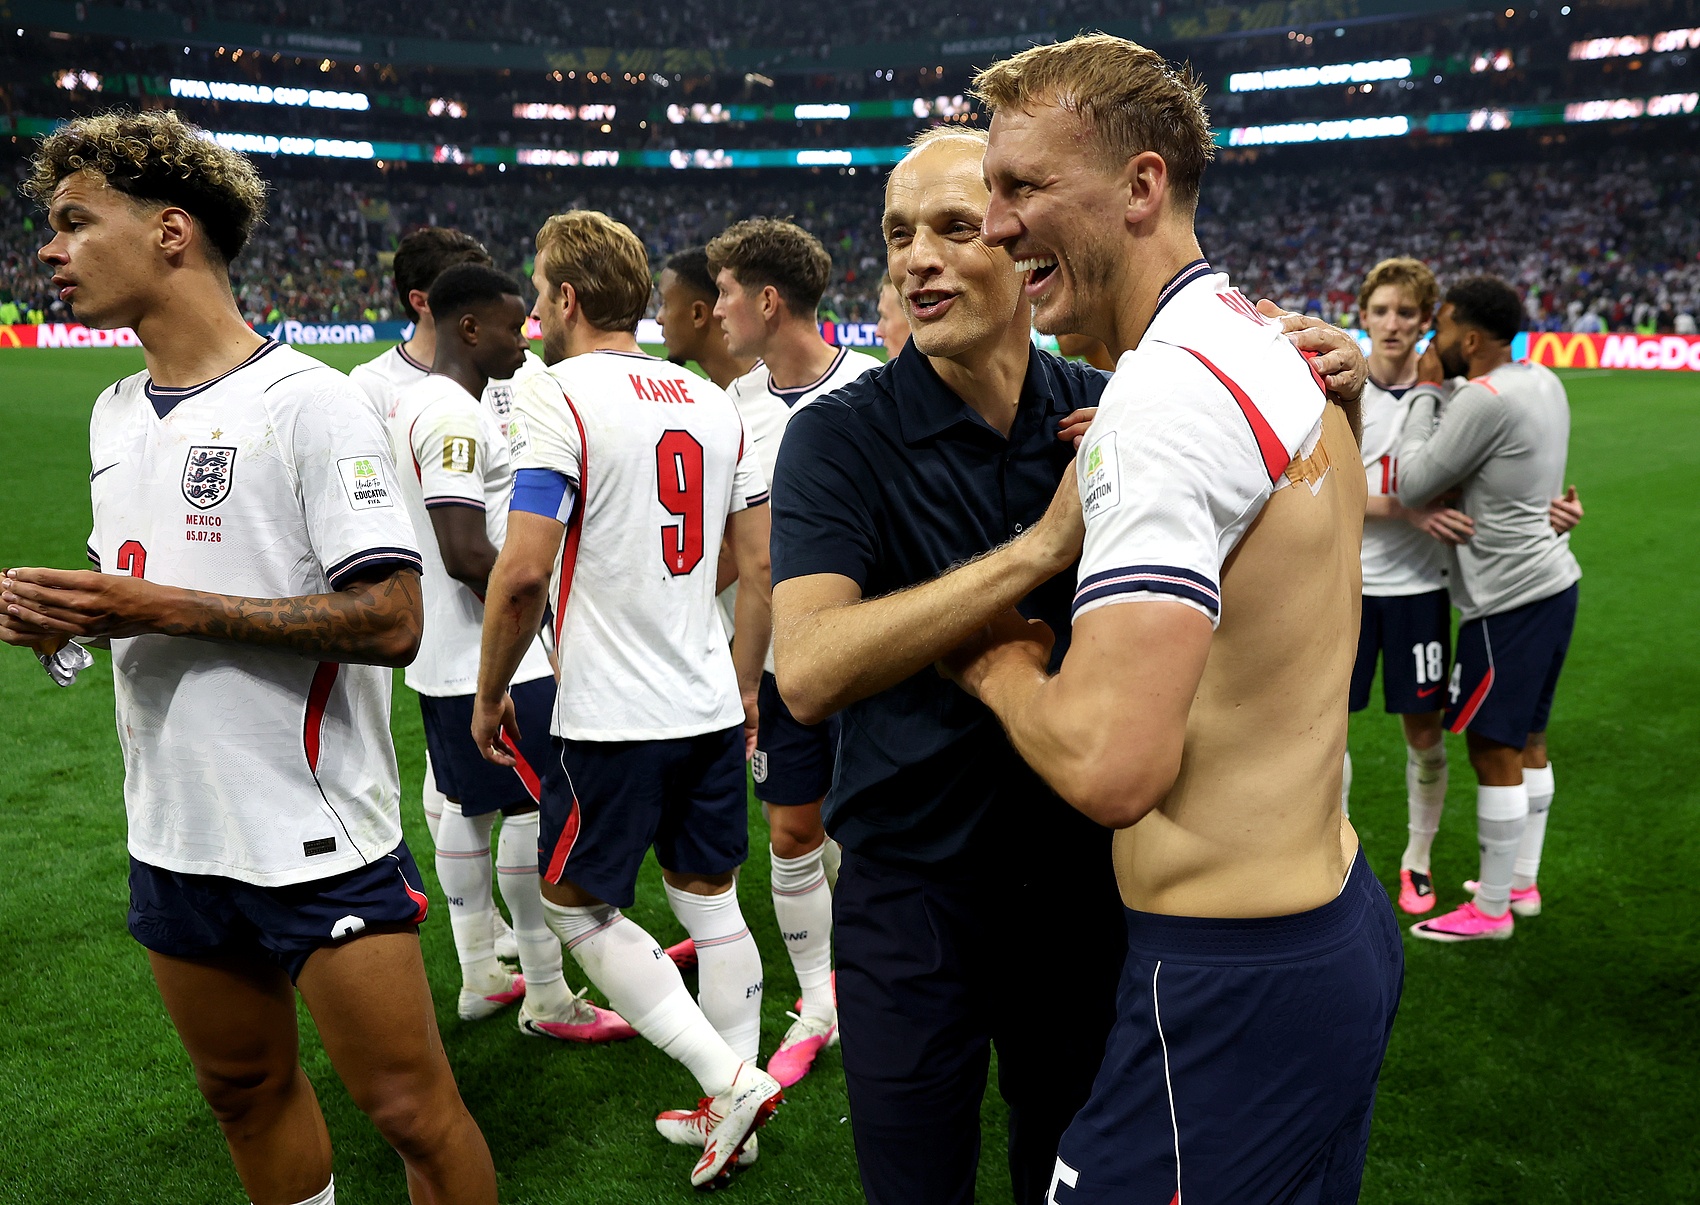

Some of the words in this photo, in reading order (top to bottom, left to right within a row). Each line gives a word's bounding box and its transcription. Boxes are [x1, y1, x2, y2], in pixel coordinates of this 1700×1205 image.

[209, 82, 273, 103] WORLD
[273, 87, 308, 105] CUP
[279, 137, 315, 155] CUP
[285, 321, 375, 345] Rexona
[837, 323, 884, 346] ULT
[628, 373, 695, 404] KANE
[655, 428, 704, 577] 9
[186, 514, 222, 527] MEXICO
[186, 530, 222, 543] 05.07.26
[1412, 640, 1443, 684] 18
[447, 896, 463, 907] NG
